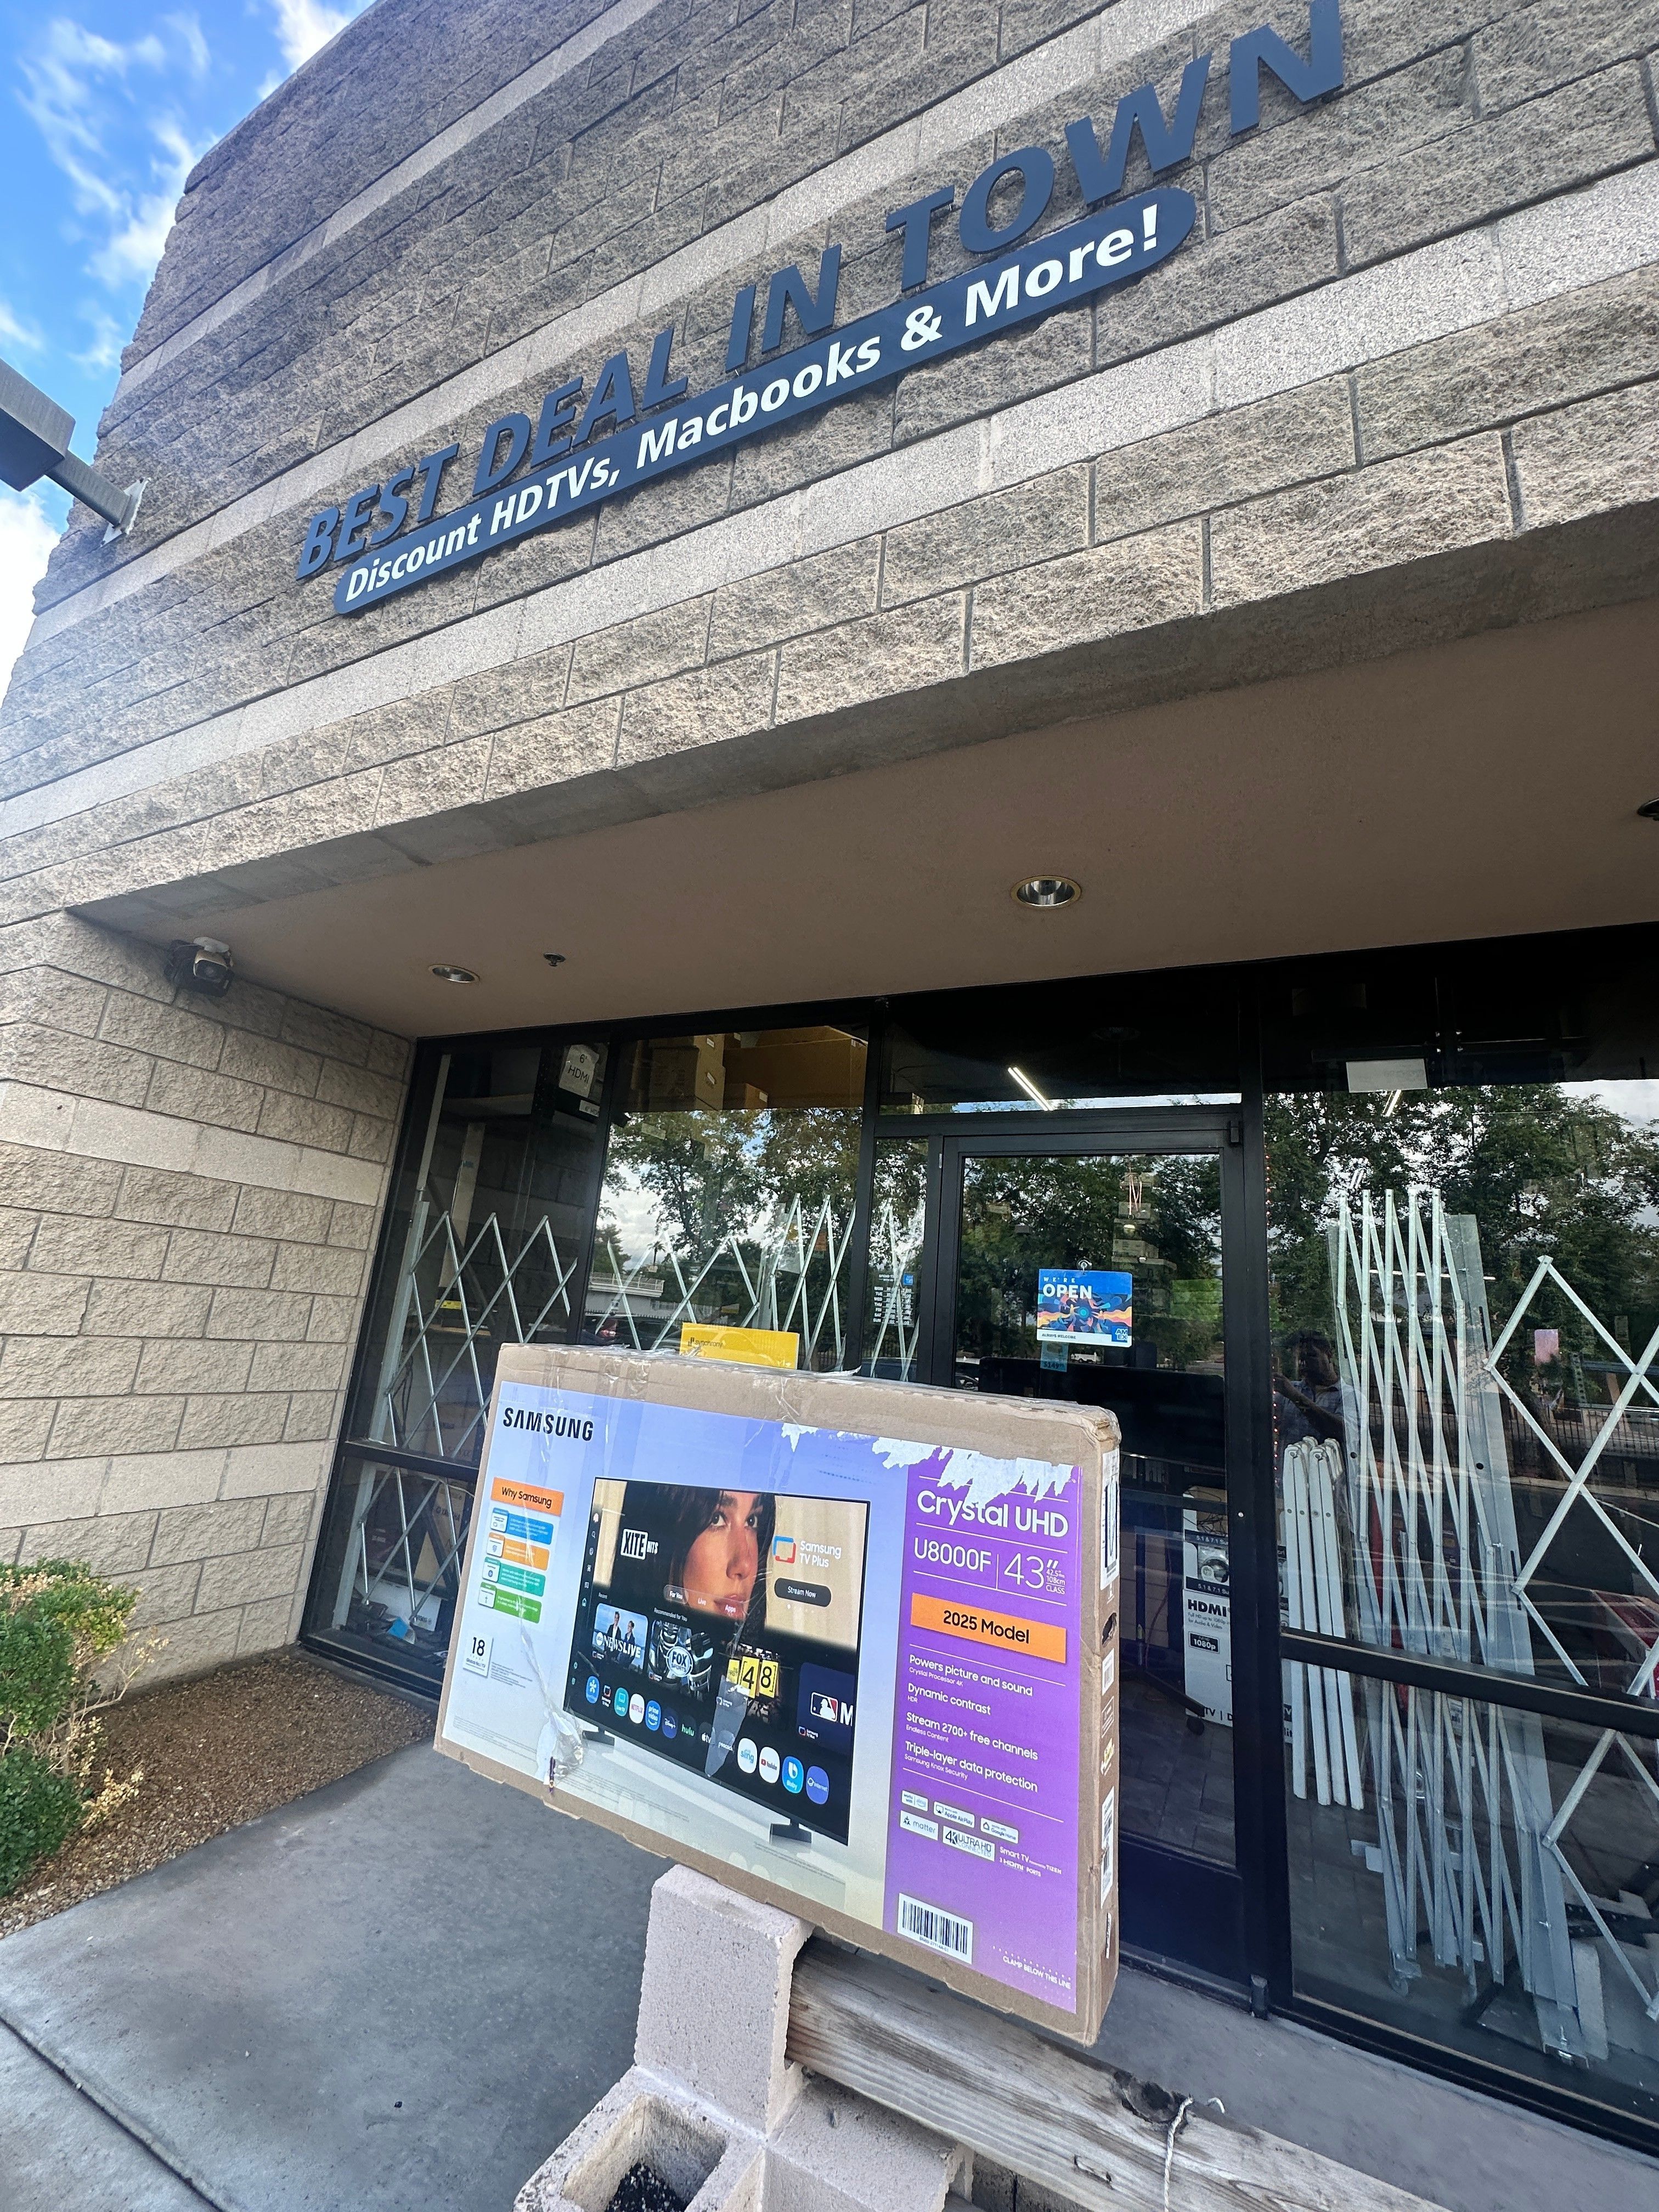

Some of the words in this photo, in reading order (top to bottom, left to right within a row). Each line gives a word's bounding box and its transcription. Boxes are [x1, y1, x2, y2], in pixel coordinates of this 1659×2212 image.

[296, 443, 460, 580] BEST
[473, 328, 689, 495] DEAL
[725, 244, 842, 373] IN
[885, 0, 1344, 292] TOWN
[346, 513, 482, 602] Discount
[490, 456, 620, 535] HDTVs,
[636, 336, 881, 470] Macbooks
[900, 306, 944, 352] &
[964, 203, 1159, 327] More!
[568, 1064, 590, 1084] HDMI
[1043, 1283, 1092, 1299] OPEN
[695, 1339, 724, 1348] synchrony
[503, 1407, 594, 1441] SAMSUNG
[501, 1486, 517, 1500] Why
[518, 1491, 552, 1509] Samsung
[917, 1489, 1008, 1528] Crystal
[1015, 1505, 1069, 1537] UHD
[623, 1531, 646, 1558] XITE
[800, 1540, 842, 1560] Samsung
[913, 1537, 992, 1572] U8000F
[800, 1553, 810, 1565] TV
[811, 1555, 830, 1568] Plus
[1046, 1575, 1065, 1585] 108cm
[1046, 1584, 1065, 1595] CLASS
[787, 1585, 805, 1596] Stream
[805, 1589, 817, 1599] Now
[1187, 1599, 1227, 1618] HDMI
[943, 1610, 978, 1630] 2025
[981, 1618, 1030, 1644] Model
[472, 1637, 485, 1657] 18
[1193, 1638, 1216, 1651] 1080p
[672, 1650, 687, 1667] FOX
[909, 1654, 944, 1672] Powers
[945, 1664, 979, 1681] picture
[980, 1674, 1000, 1688] and
[1002, 1681, 1033, 1697] sound
[909, 1667, 928, 1678] Crystal
[928, 1672, 955, 1686] Processor
[956, 1679, 963, 1688] 4K
[907, 1695, 918, 1703] HDR
[908, 1682, 949, 1703] Dynamic
[950, 1695, 991, 1716] contrast
[681, 1723, 695, 1737] hulu
[906, 1724, 926, 1736] Endless
[927, 1730, 950, 1743] Content
[906, 1711, 940, 1730] Stream
[941, 1722, 968, 1738] 2700+
[969, 1729, 991, 1746] free
[992, 1738, 1039, 1760] channels
[740, 1749, 754, 1764] sling
[905, 1740, 958, 1766] Triple-layer
[959, 1759, 984, 1775] data
[984, 1768, 1038, 1793] protection
[904, 1753, 930, 1769] Samsung
[930, 1762, 945, 1773] Knox
[945, 1767, 968, 1781] Security
[944, 1811, 957, 1821] Apple
[912, 1820, 936, 1834] matter
[991, 1827, 1005, 1837] Google
[1005, 1831, 1017, 1841] Home
[945, 1830, 958, 1845] 4K
[958, 1833, 980, 1849] ULTRA
[981, 1841, 992, 1853] HD
[958, 1842, 992, 1858] CONNECTED
[999, 1846, 1020, 1859] Smart
[1020, 1853, 1030, 1863] TV
[1002, 1955, 1023, 1969] CLAMP
[1023, 1962, 1044, 1978] BELOW
[1045, 1972, 1058, 1985] THIS
[1058, 1978, 1071, 1990] LINE
